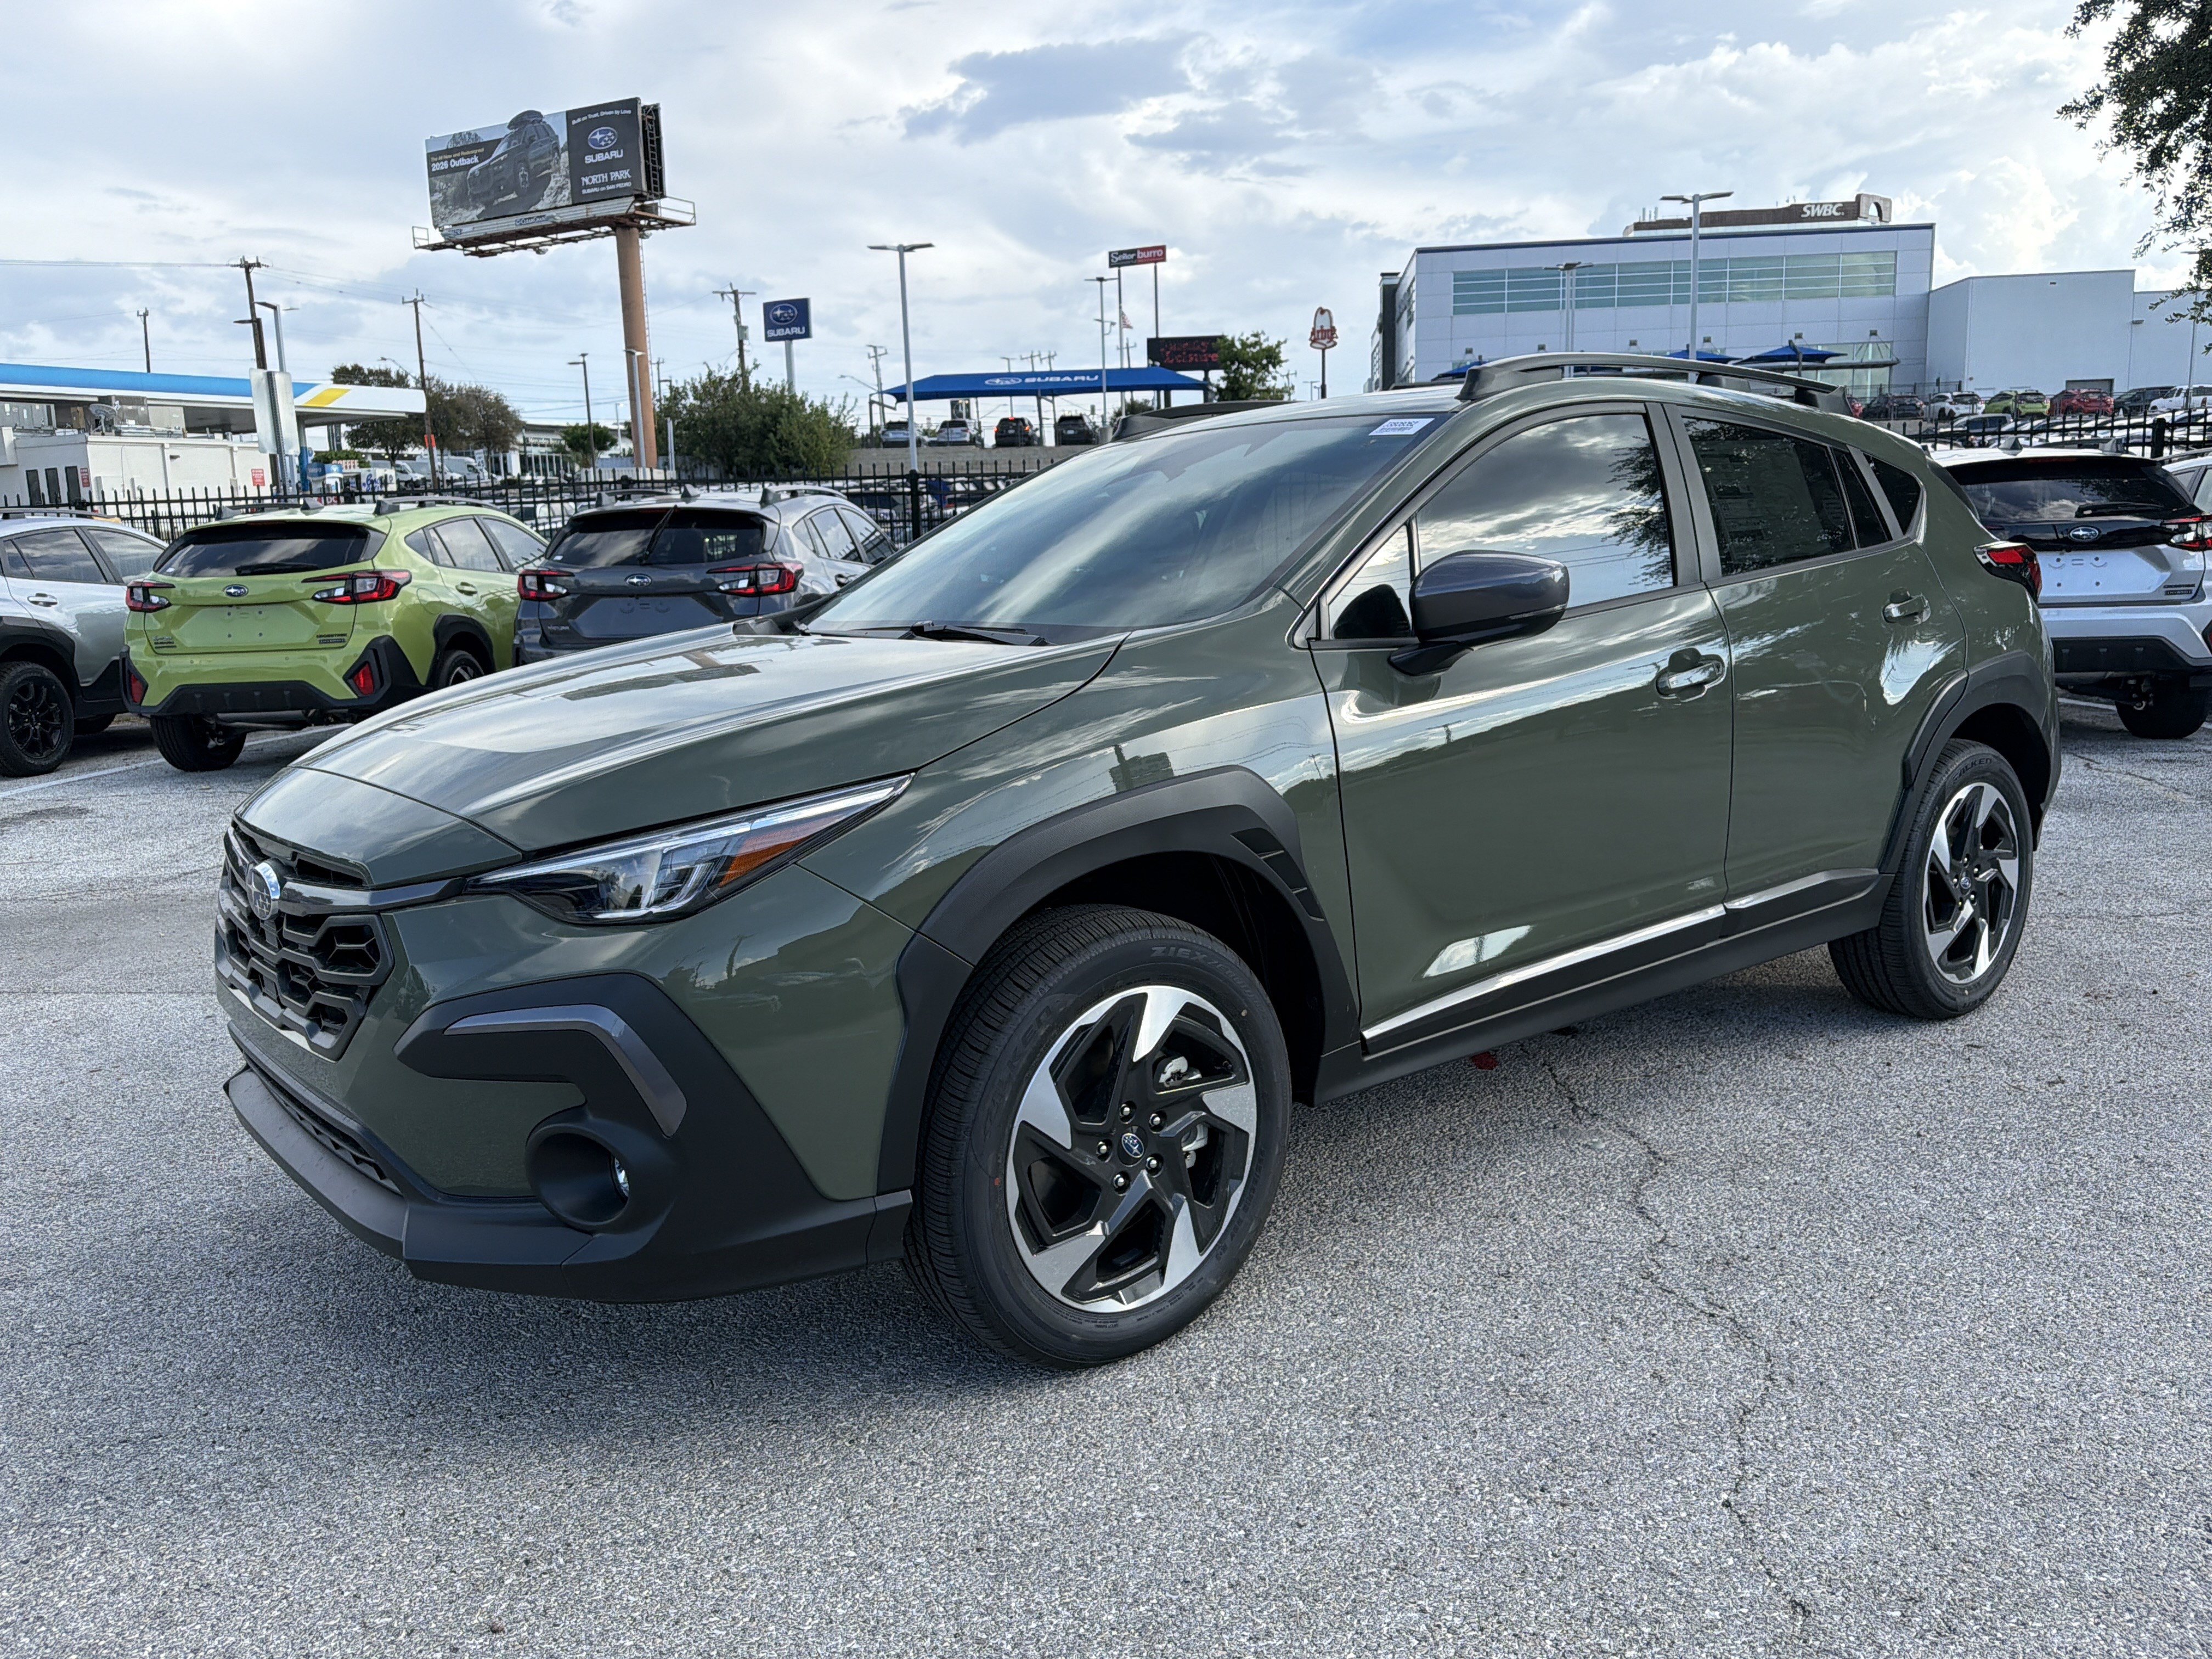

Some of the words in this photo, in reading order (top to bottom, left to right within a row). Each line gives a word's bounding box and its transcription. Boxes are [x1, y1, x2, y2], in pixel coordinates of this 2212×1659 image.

[585, 149, 623, 163] SUBARU
[431, 160, 448, 172] 2026
[450, 155, 479, 168] Outback
[581, 173, 608, 186] NORTH
[609, 168, 632, 181] PARK
[1137, 249, 1163, 259] burro
[767, 326, 805, 337] SUBARU
[1025, 375, 1099, 383] SUBARU
[1150, 946, 1208, 962] ZIEX
